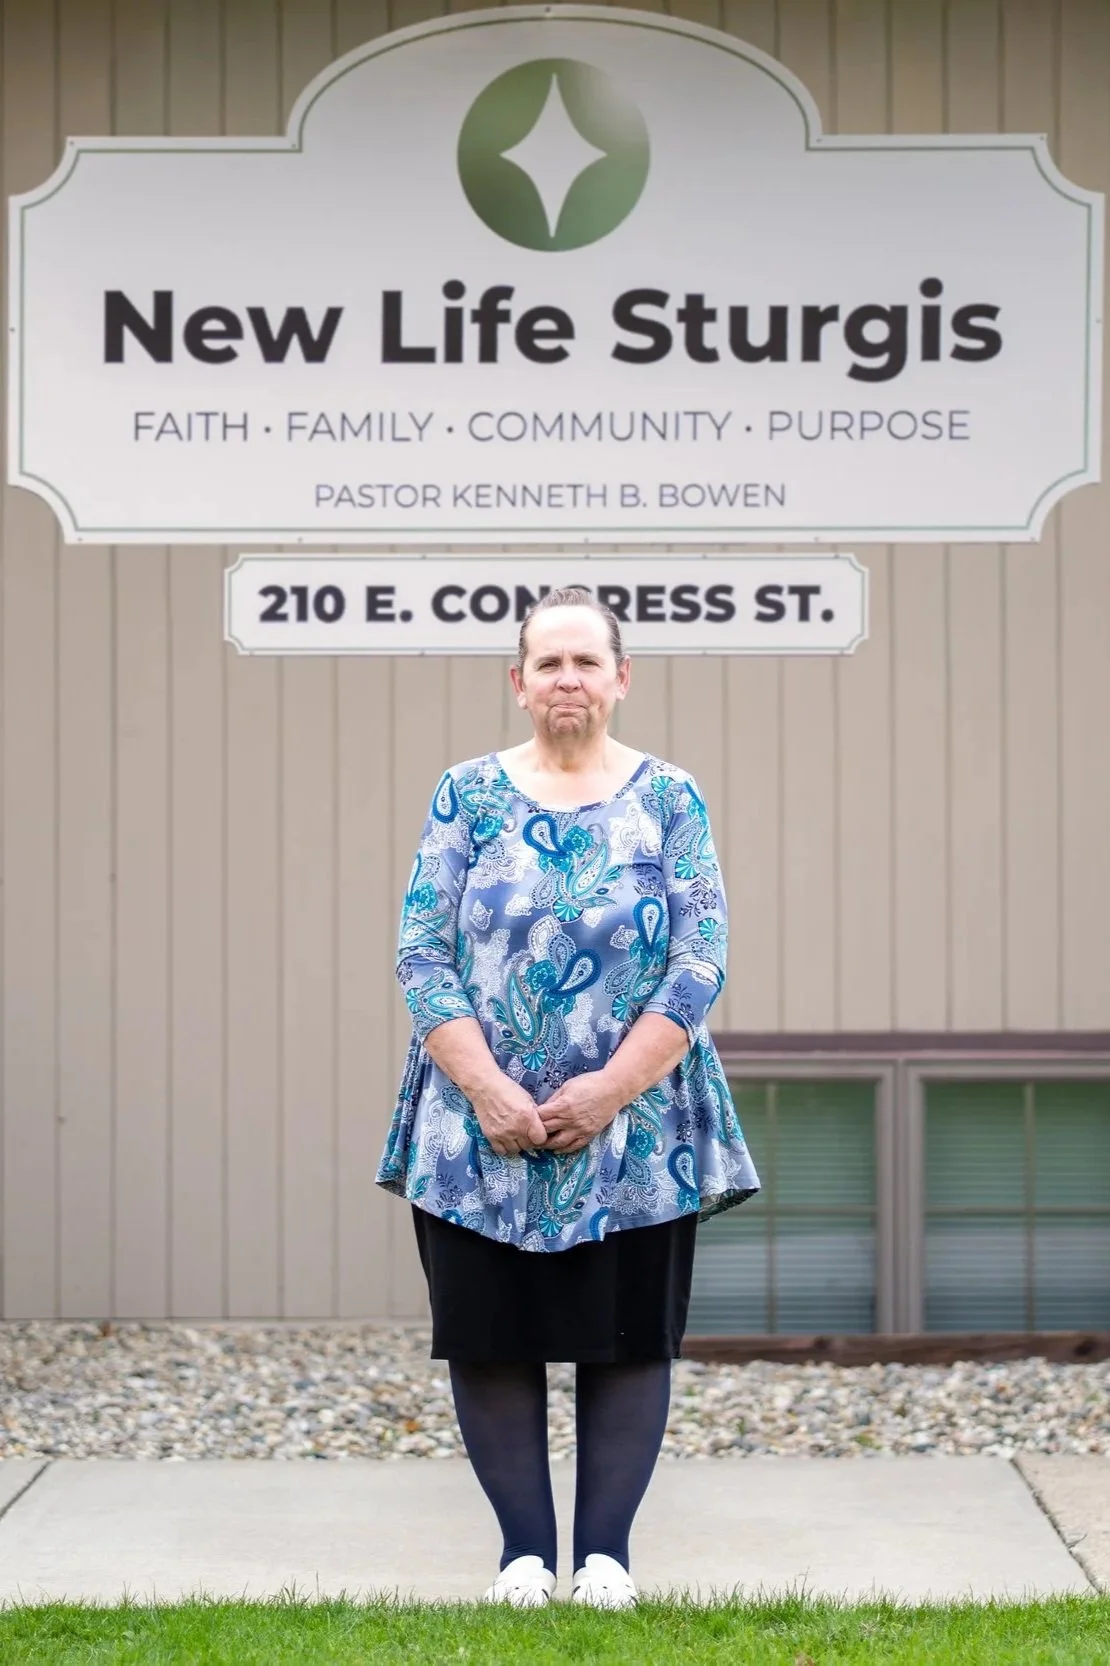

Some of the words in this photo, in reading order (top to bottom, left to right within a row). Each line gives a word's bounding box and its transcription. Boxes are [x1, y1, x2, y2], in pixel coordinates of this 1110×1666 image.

[103, 290, 345, 365] New
[381, 279, 575, 365] Life
[611, 277, 1003, 383] Sturgis
[134, 411, 249, 442] FAITH
[287, 411, 434, 442] FAMILY
[468, 410, 733, 442] COMMUNITY
[769, 409, 971, 441] PURPOSE
[315, 484, 441, 509] PASTOR
[453, 483, 607, 509] KENNETH
[620, 483, 648, 508] B.
[659, 483, 786, 508] BOWEN
[258, 584, 346, 624] 210
[365, 585, 413, 624] E.
[430, 583, 737, 624] CONRESS
[753, 583, 835, 623] ST.
